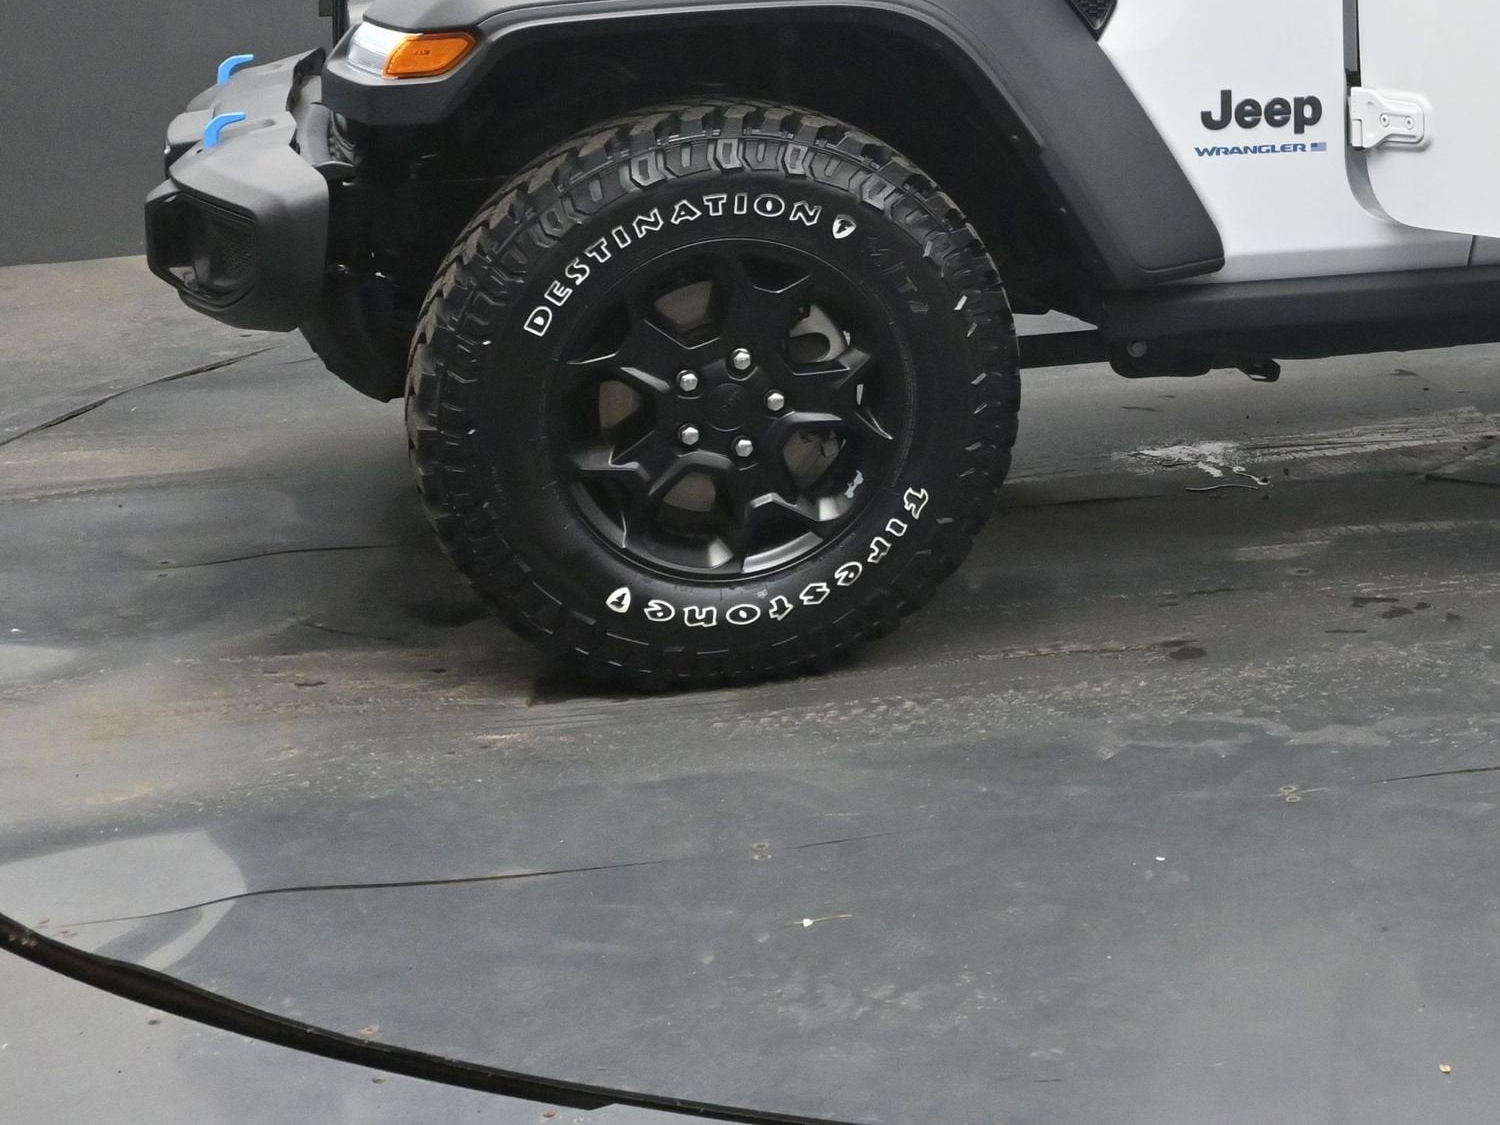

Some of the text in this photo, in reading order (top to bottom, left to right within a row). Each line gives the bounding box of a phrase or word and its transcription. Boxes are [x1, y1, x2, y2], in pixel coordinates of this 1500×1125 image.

[1194, 143, 1306, 157] WRANGLER
[1201, 89, 1322, 134] Jeep
[523, 193, 822, 336] DESTINATION
[644, 487, 929, 627] Firestone
